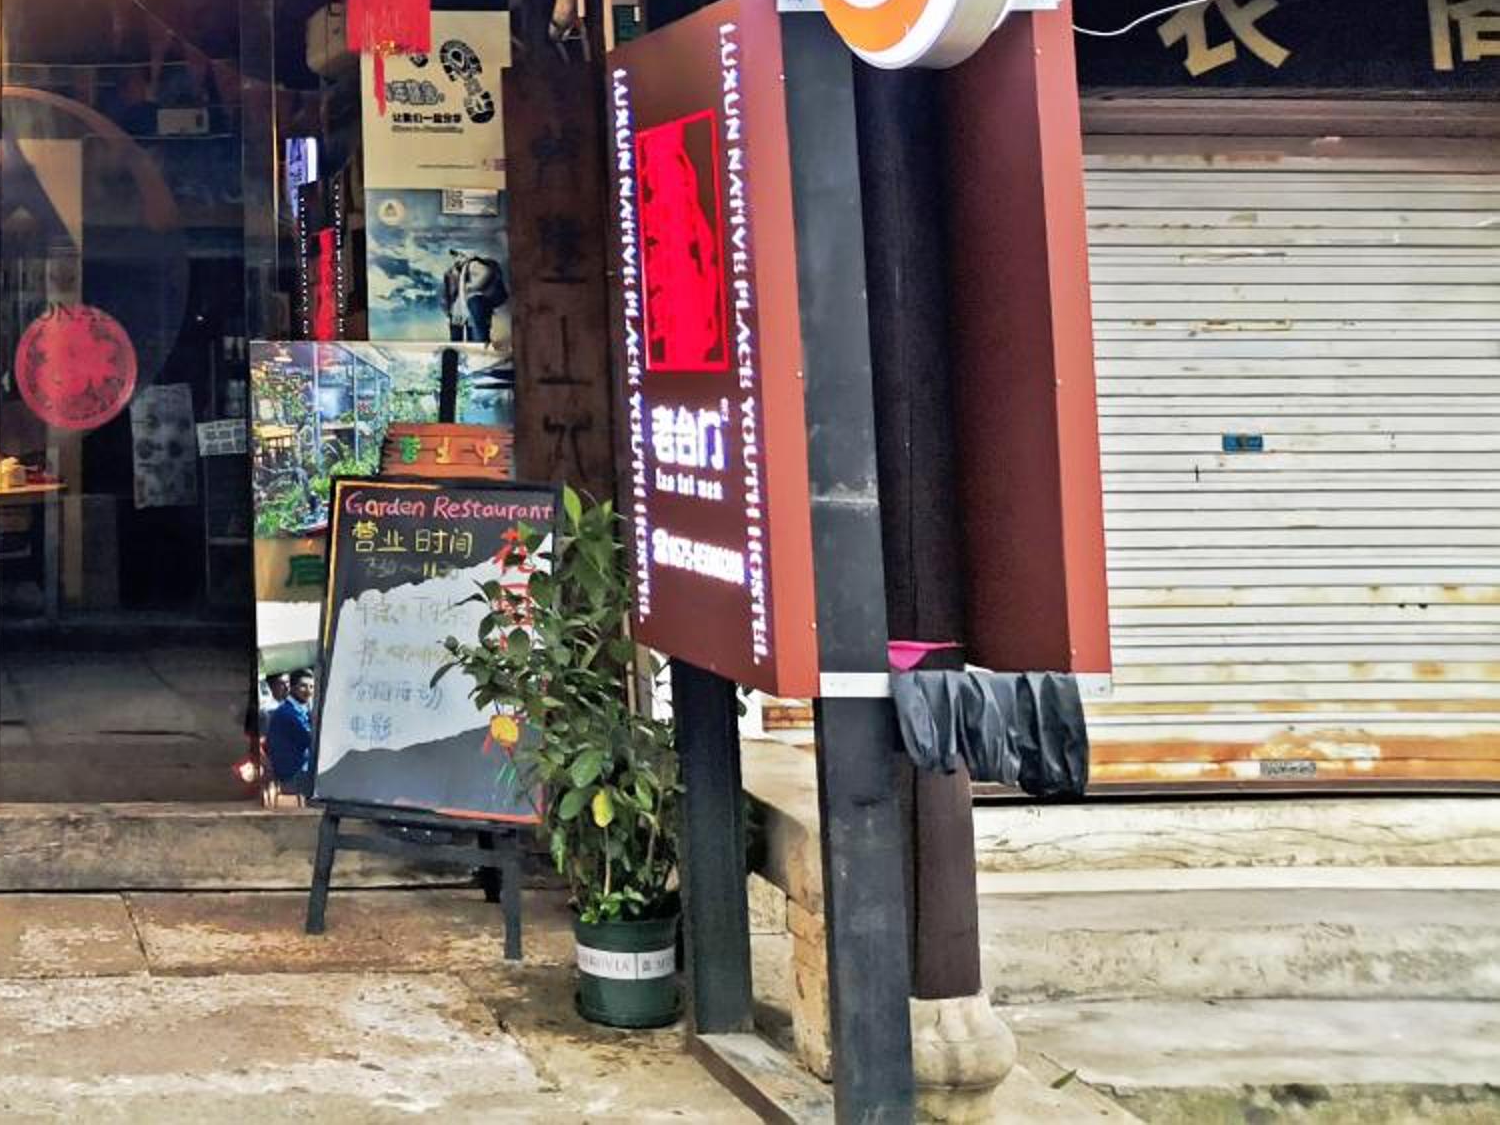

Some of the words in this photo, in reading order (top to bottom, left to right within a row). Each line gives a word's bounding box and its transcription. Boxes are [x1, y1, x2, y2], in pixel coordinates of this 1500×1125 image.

[718, 23, 742, 140] LUXUN
[345, 491, 426, 518] Garden
[433, 496, 554, 520] Restaurant
[352, 520, 473, 559] 营业时间
